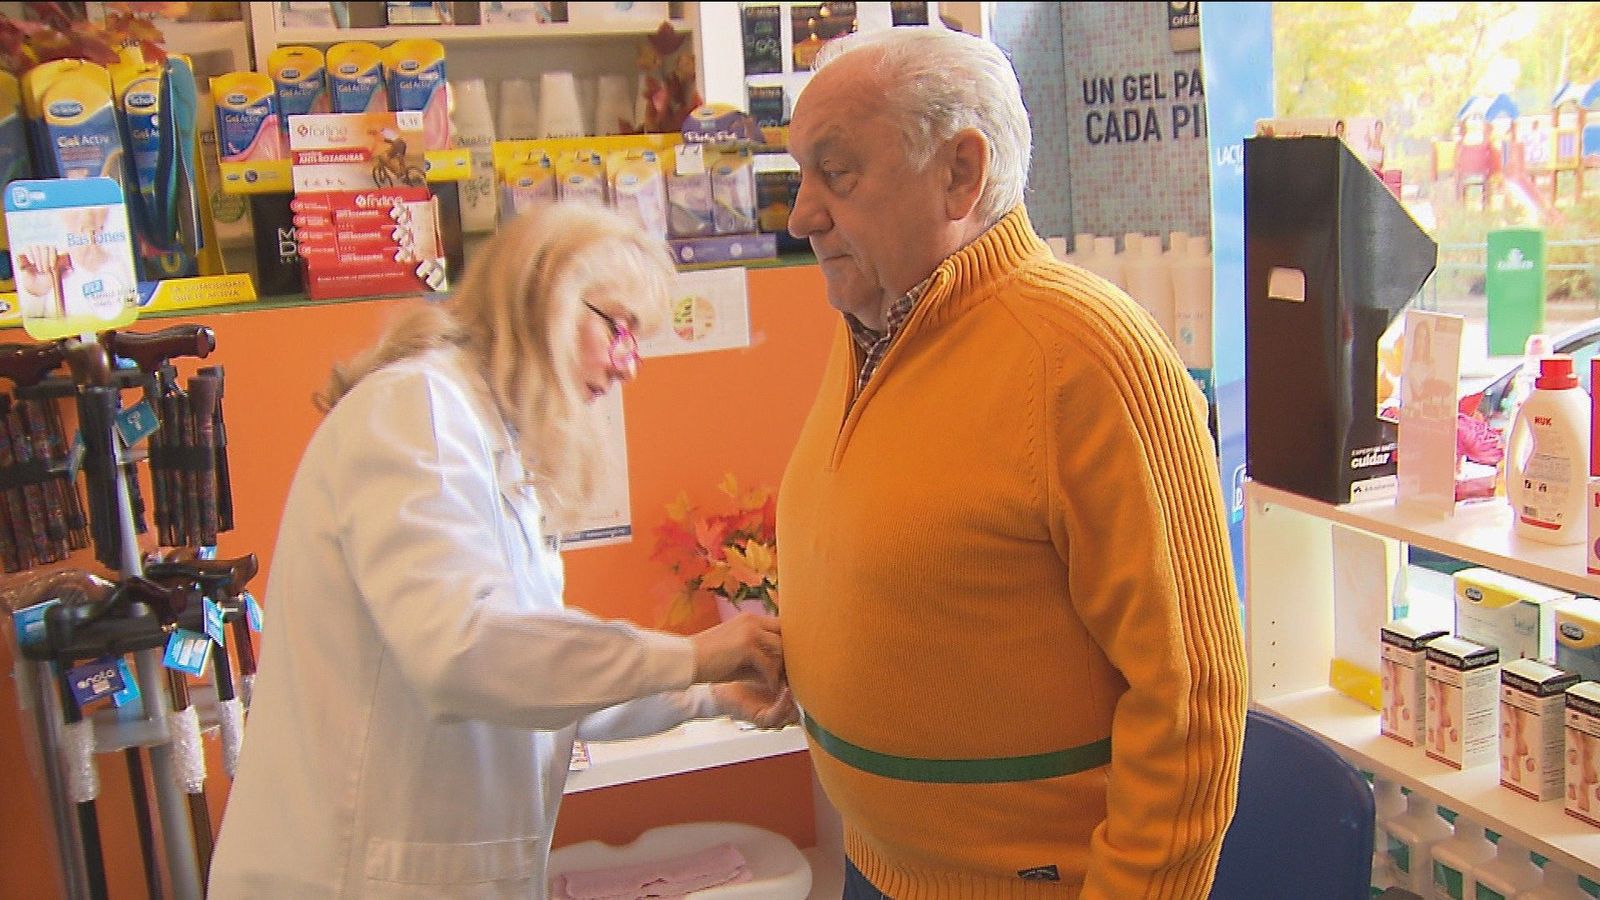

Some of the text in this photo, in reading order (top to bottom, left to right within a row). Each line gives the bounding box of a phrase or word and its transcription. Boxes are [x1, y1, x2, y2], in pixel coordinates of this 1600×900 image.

[1083, 68, 1204, 105] UN GEL PA
[1086, 103, 1207, 144] CADA PI
[1534, 416, 1552, 426] NUK
[1350, 452, 1391, 469] cuidar
